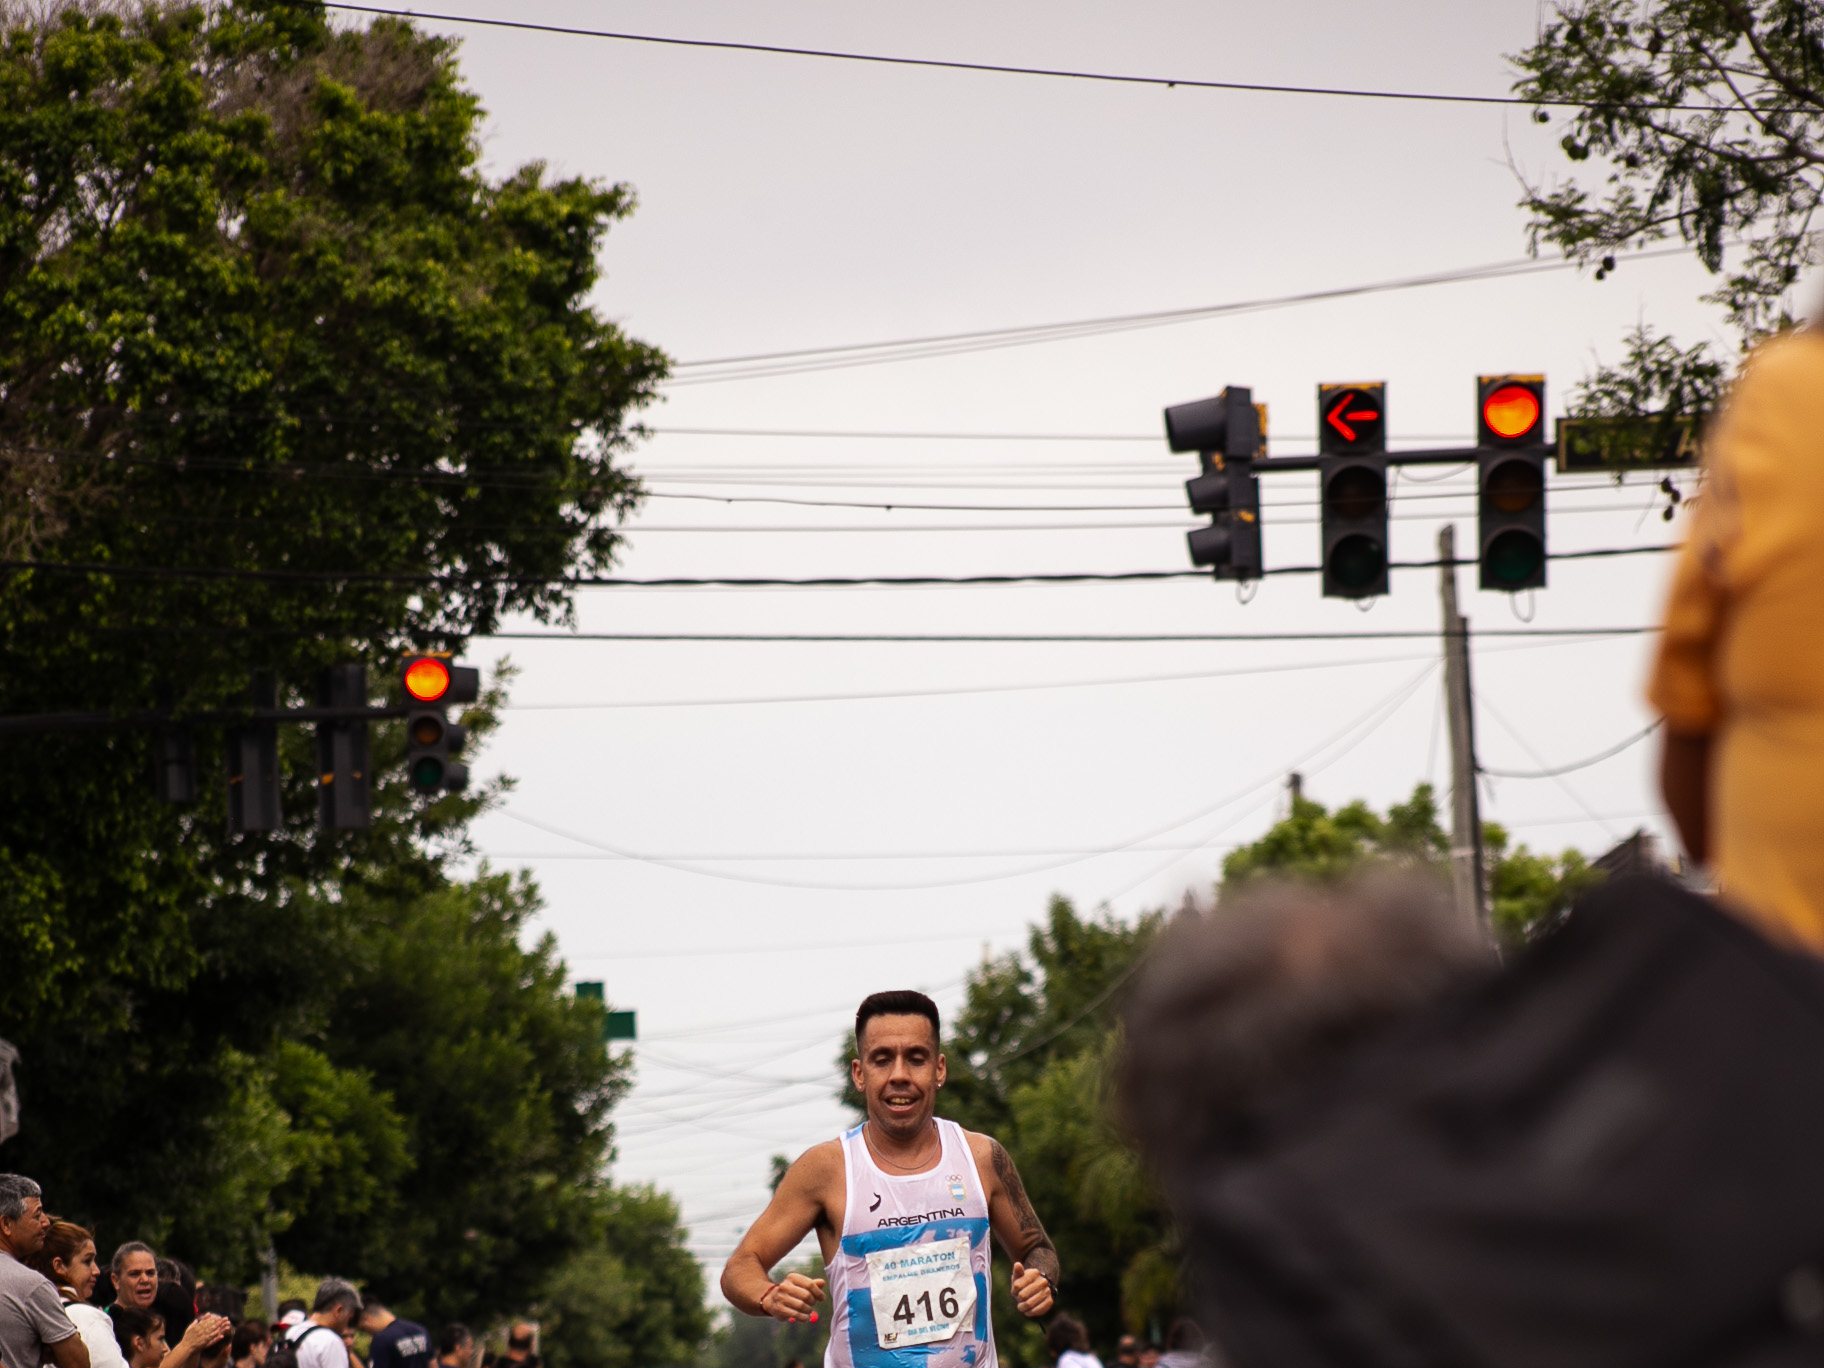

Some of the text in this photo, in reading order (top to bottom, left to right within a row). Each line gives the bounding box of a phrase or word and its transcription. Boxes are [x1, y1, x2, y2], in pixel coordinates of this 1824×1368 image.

[877, 1207, 965, 1228] ARGENTINA
[884, 1251, 955, 1271] 40 MARATON
[893, 1287, 959, 1325] 416
